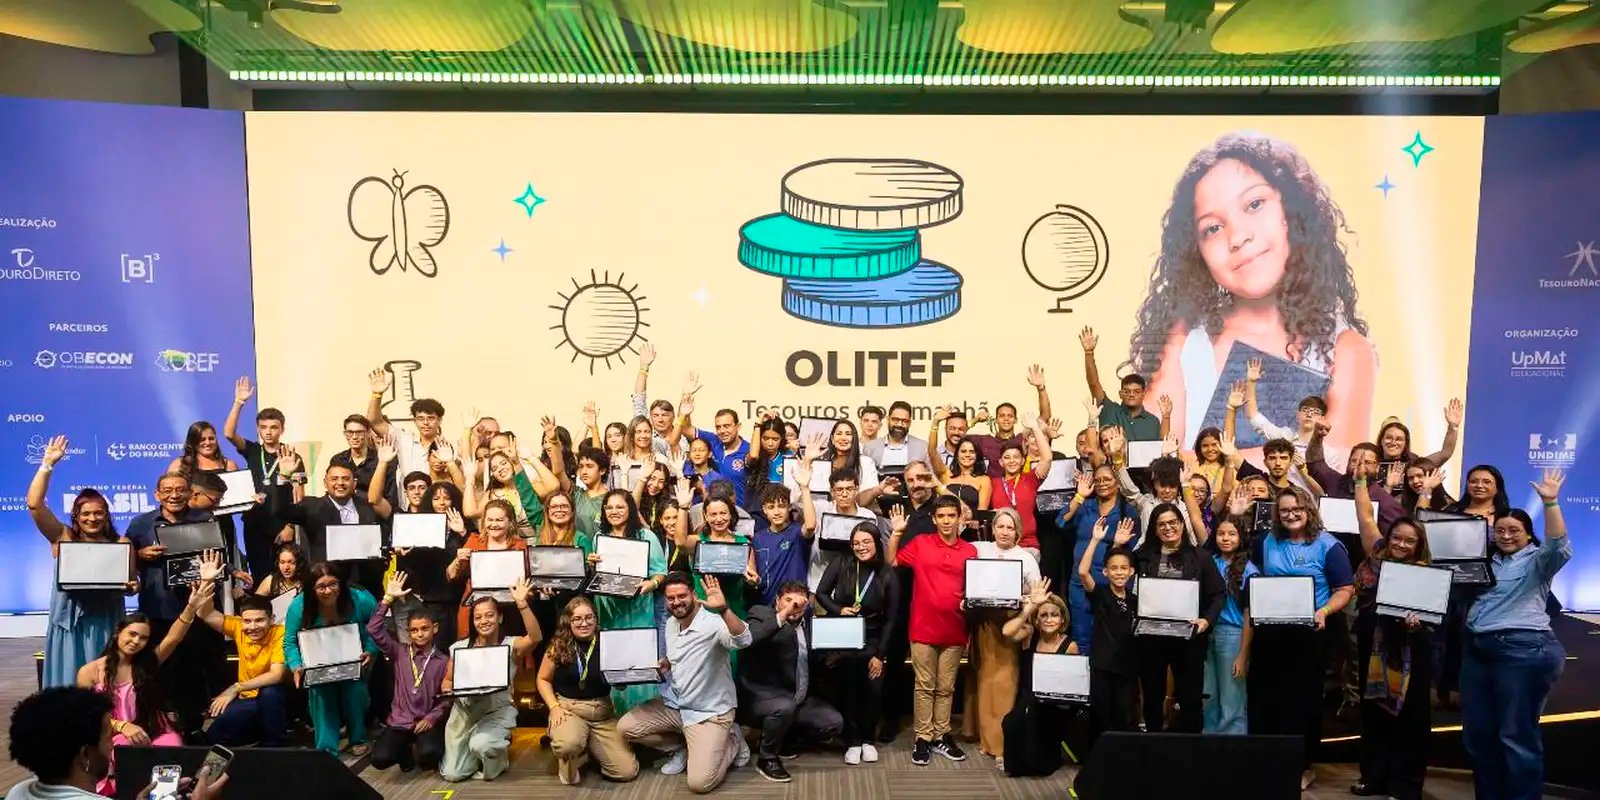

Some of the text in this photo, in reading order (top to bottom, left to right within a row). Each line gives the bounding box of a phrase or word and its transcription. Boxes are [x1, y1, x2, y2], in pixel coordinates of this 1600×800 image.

[49, 323, 108, 332] PARCEIROS
[1504, 327, 1579, 340] ORGANIZAÇÃO
[60, 351, 133, 365] OBECON
[785, 350, 956, 387] OLITEF
[7, 414, 44, 423] APOIO
[1528, 451, 1576, 460] UNDIME
